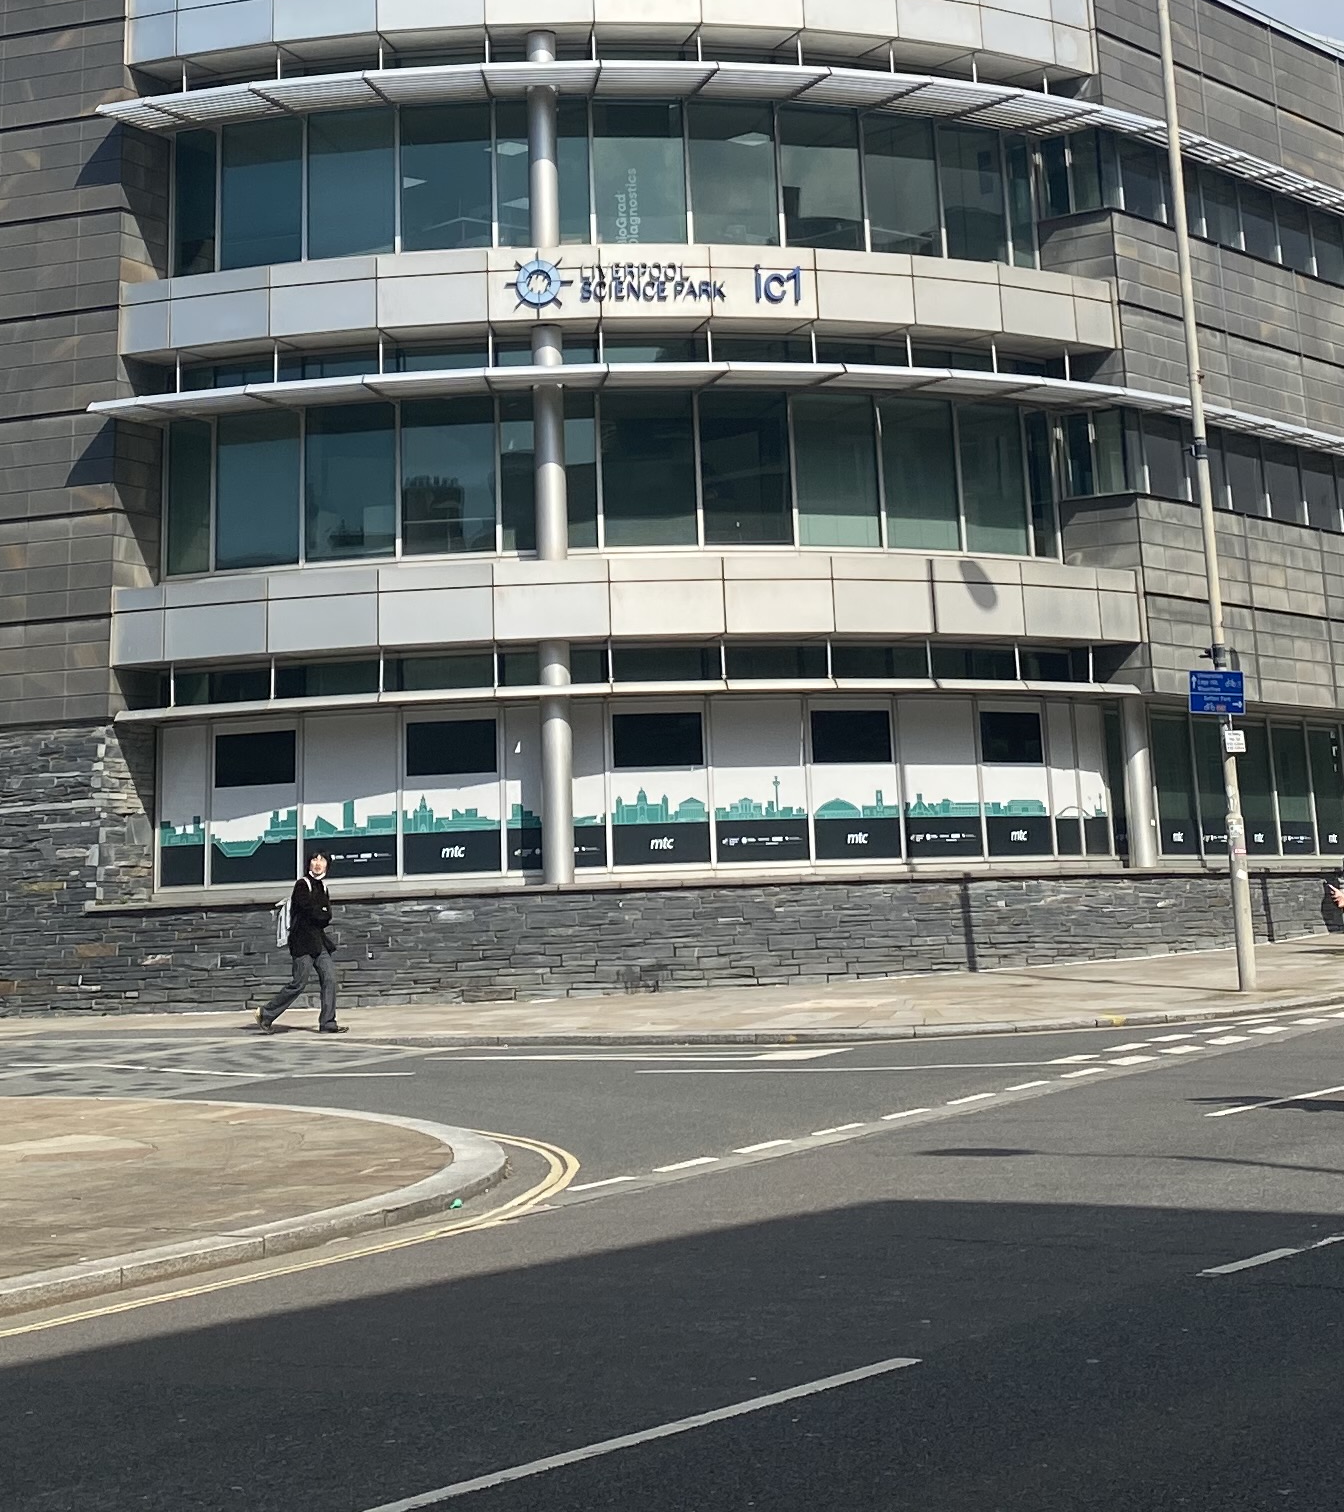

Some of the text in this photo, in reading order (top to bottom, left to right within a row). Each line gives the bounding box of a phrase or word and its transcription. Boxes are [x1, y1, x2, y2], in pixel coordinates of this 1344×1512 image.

[579, 262, 802, 306] LIVERPOOL ic1
[579, 280, 727, 303] SCIENCE PARK
[846, 830, 869, 845] mtc
[1010, 829, 1028, 841] mtc
[650, 836, 674, 850] mtc
[441, 845, 466, 858] mtc
